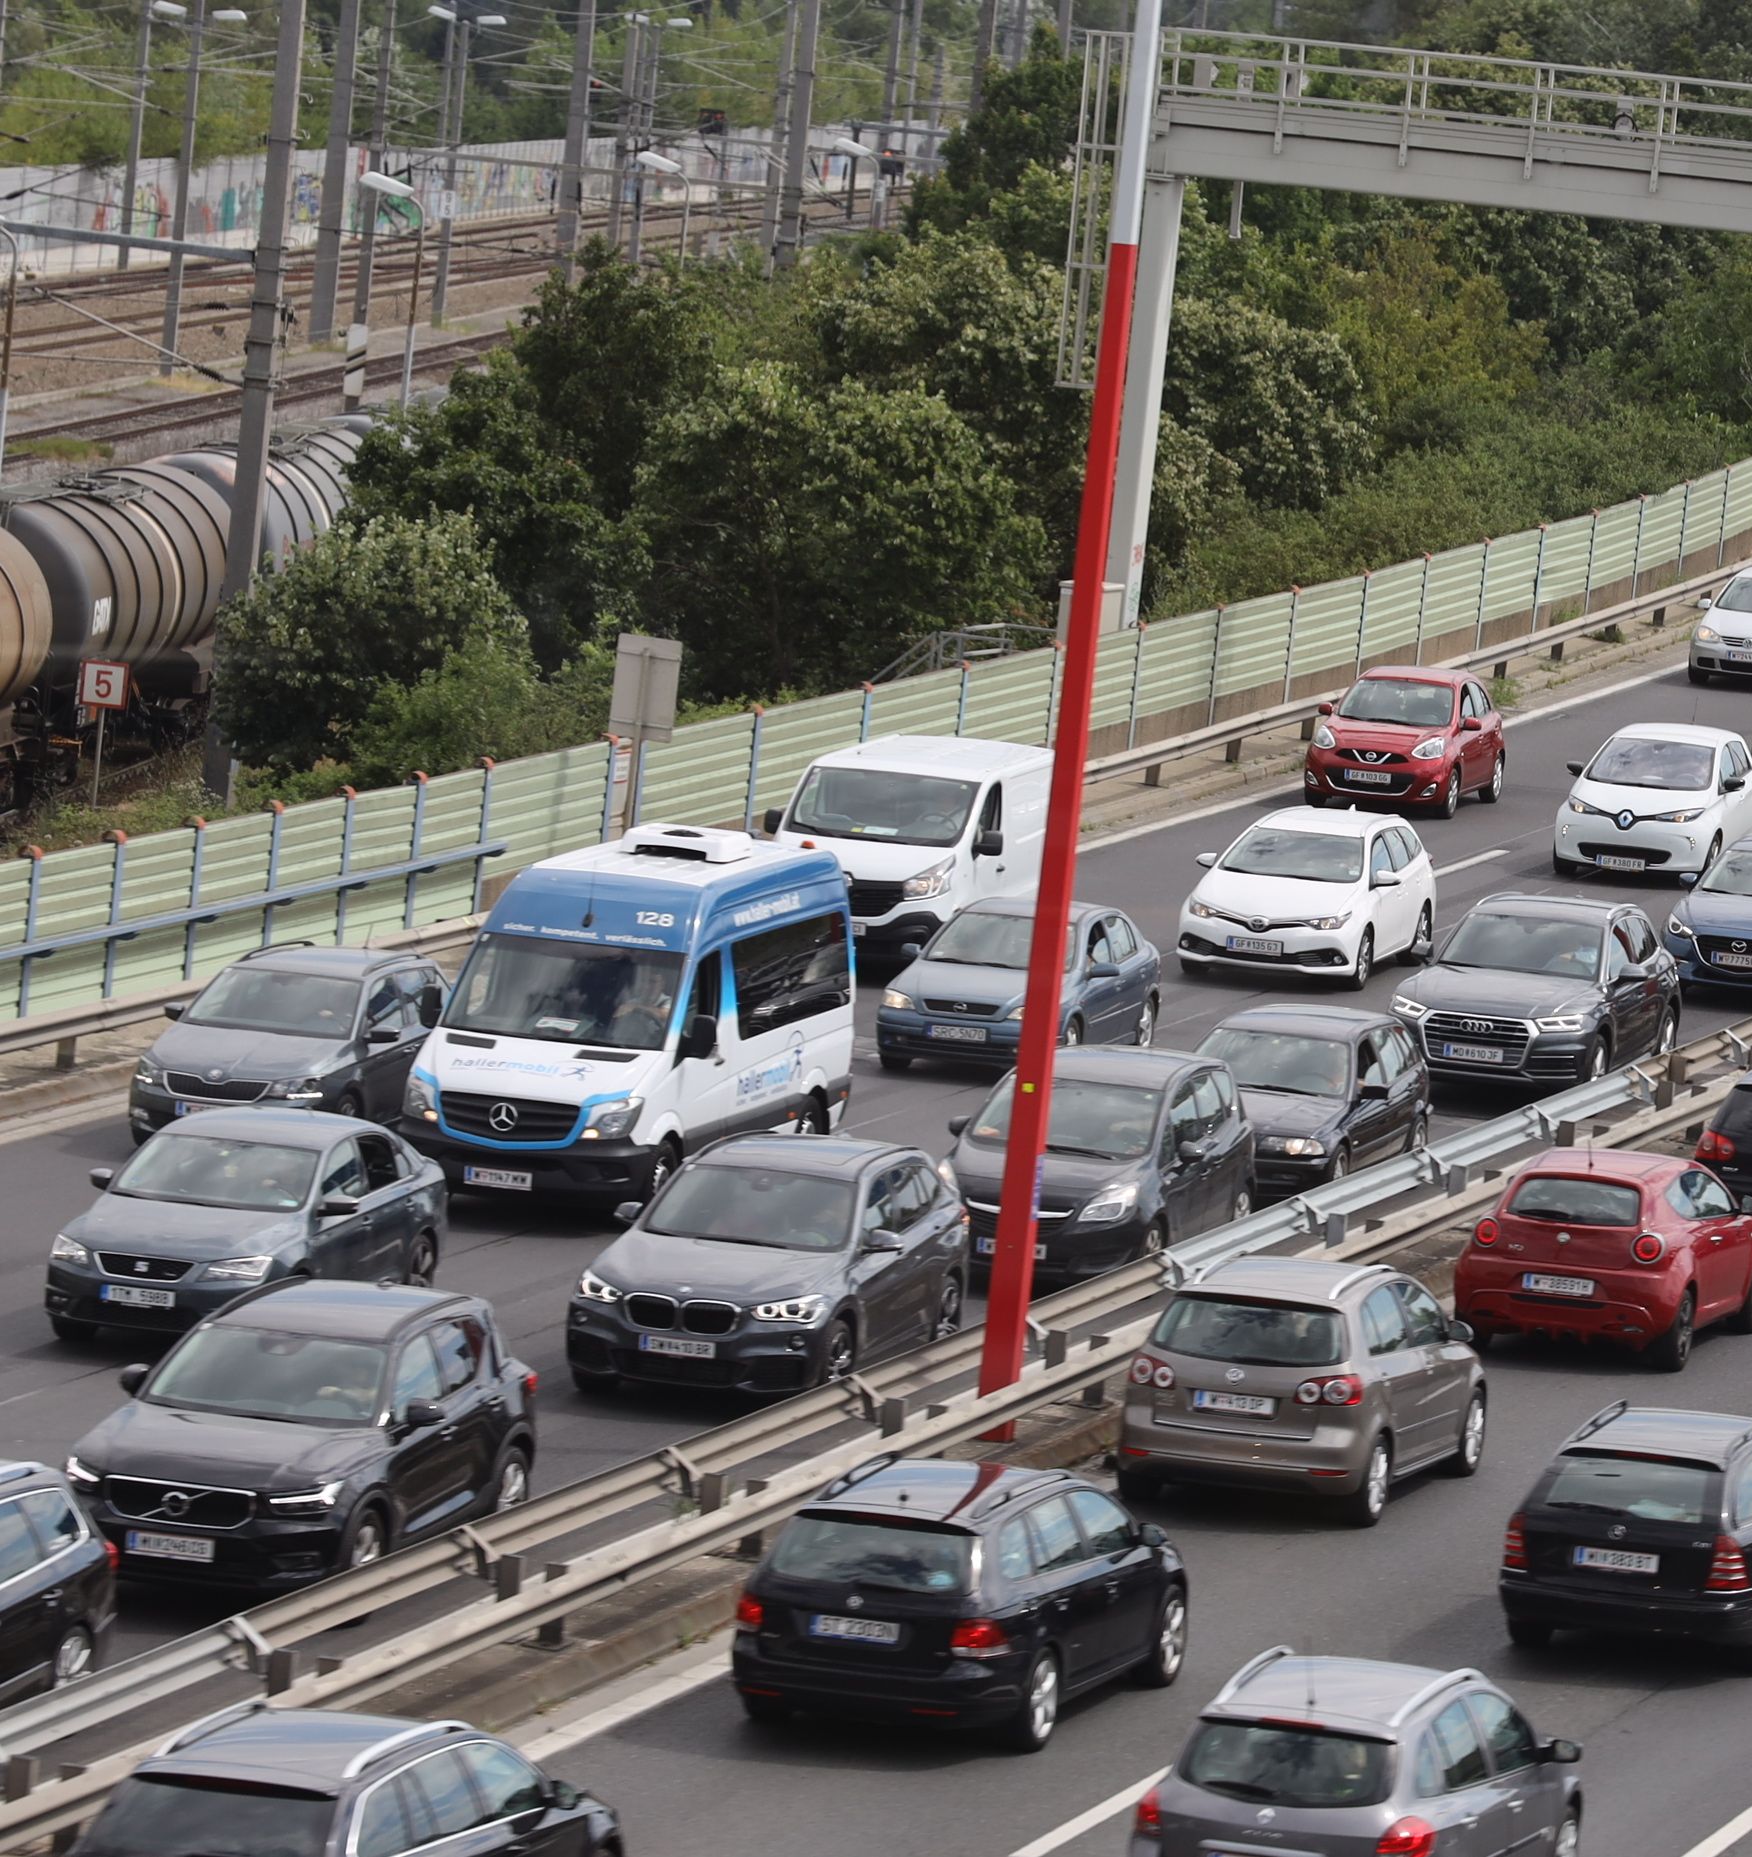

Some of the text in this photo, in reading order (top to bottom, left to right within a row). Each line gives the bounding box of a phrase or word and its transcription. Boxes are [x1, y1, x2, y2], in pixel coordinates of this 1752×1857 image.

[94, 670, 112, 699] 5
[636, 911, 674, 927] 128
[541, 925, 598, 940] kompetent.
[605, 931, 667, 946] verlässlich.
[1235, 939, 1247, 949] GF
[1252, 940, 1266, 950] 135
[452, 1056, 561, 1076] hallermobil
